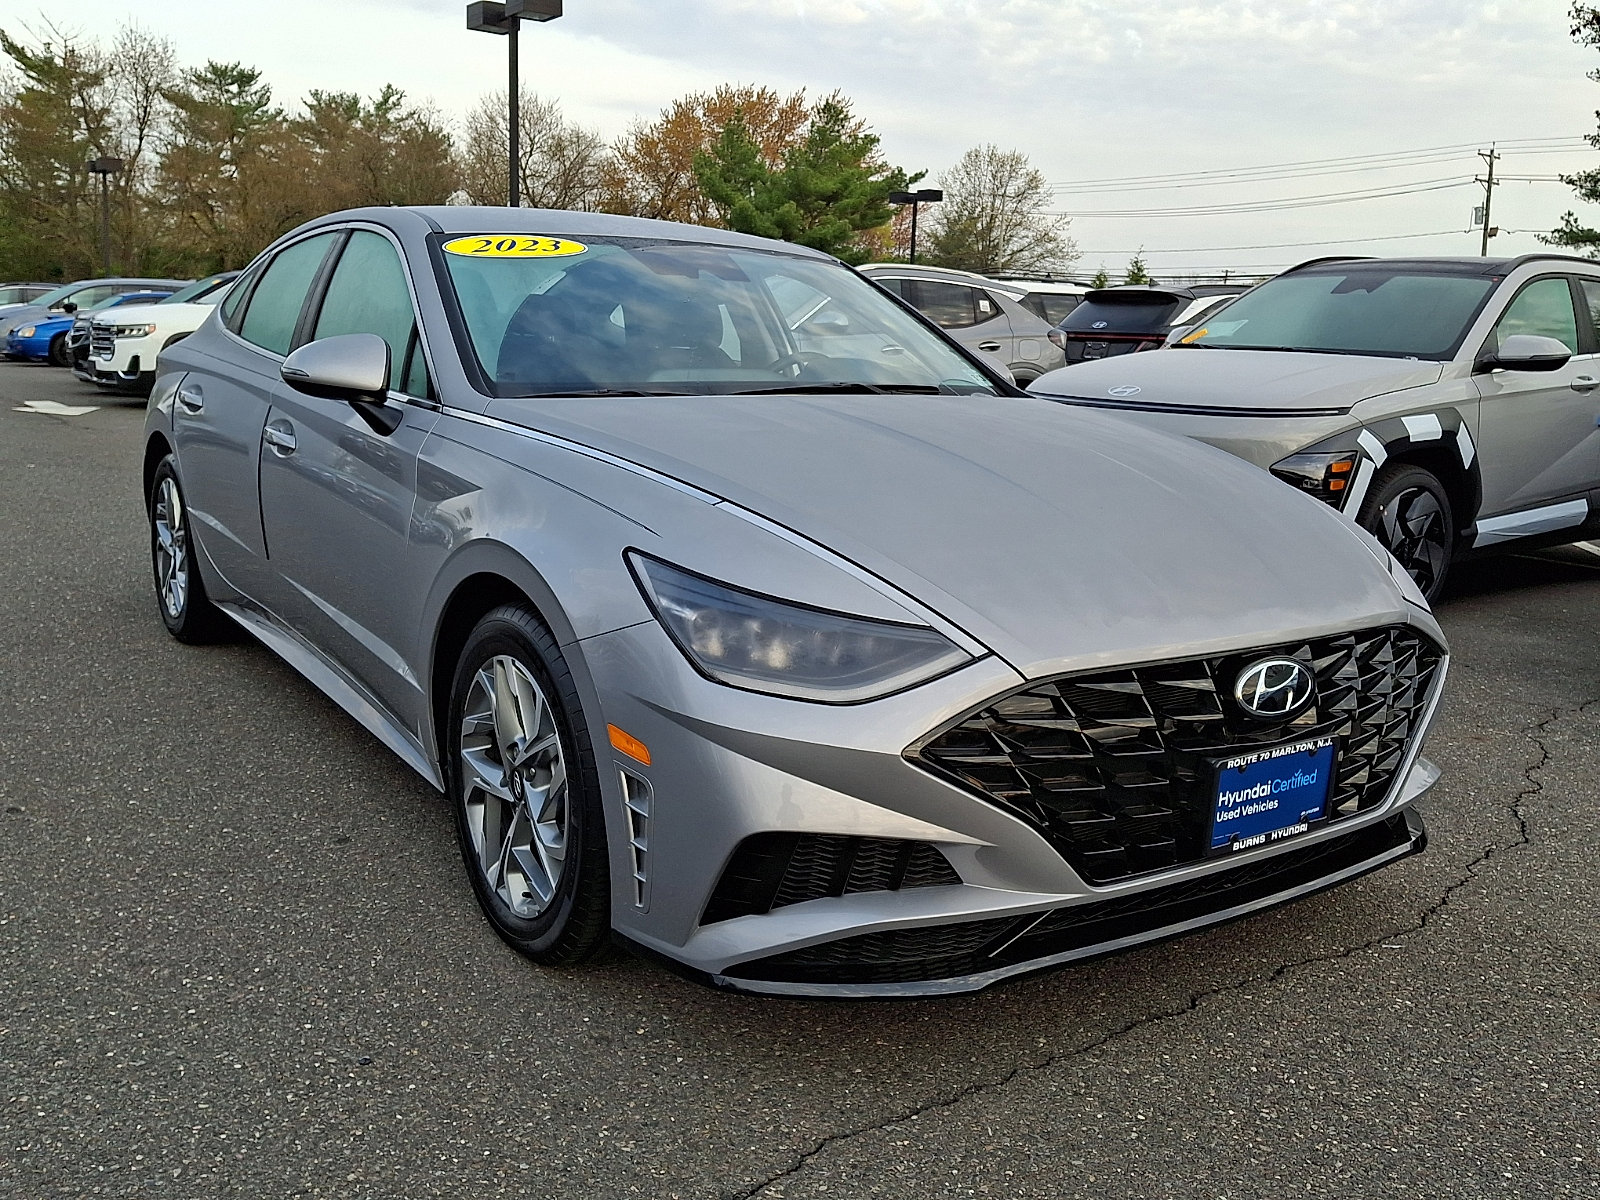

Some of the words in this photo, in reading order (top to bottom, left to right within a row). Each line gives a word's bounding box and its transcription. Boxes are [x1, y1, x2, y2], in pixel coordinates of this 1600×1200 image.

[471, 238, 562, 253] 2023
[1227, 754, 1258, 769] ROUTE
[1259, 752, 1270, 762] 70
[1272, 742, 1315, 758] MARLTON,
[1317, 738, 1333, 748] N.J.
[1218, 780, 1271, 808] Hyundai
[1272, 769, 1318, 794] Certified
[1216, 805, 1240, 822] Used
[1241, 799, 1279, 816] Vehicles
[1232, 834, 1265, 851] BURNS
[1271, 823, 1308, 840] HYUNDAI
